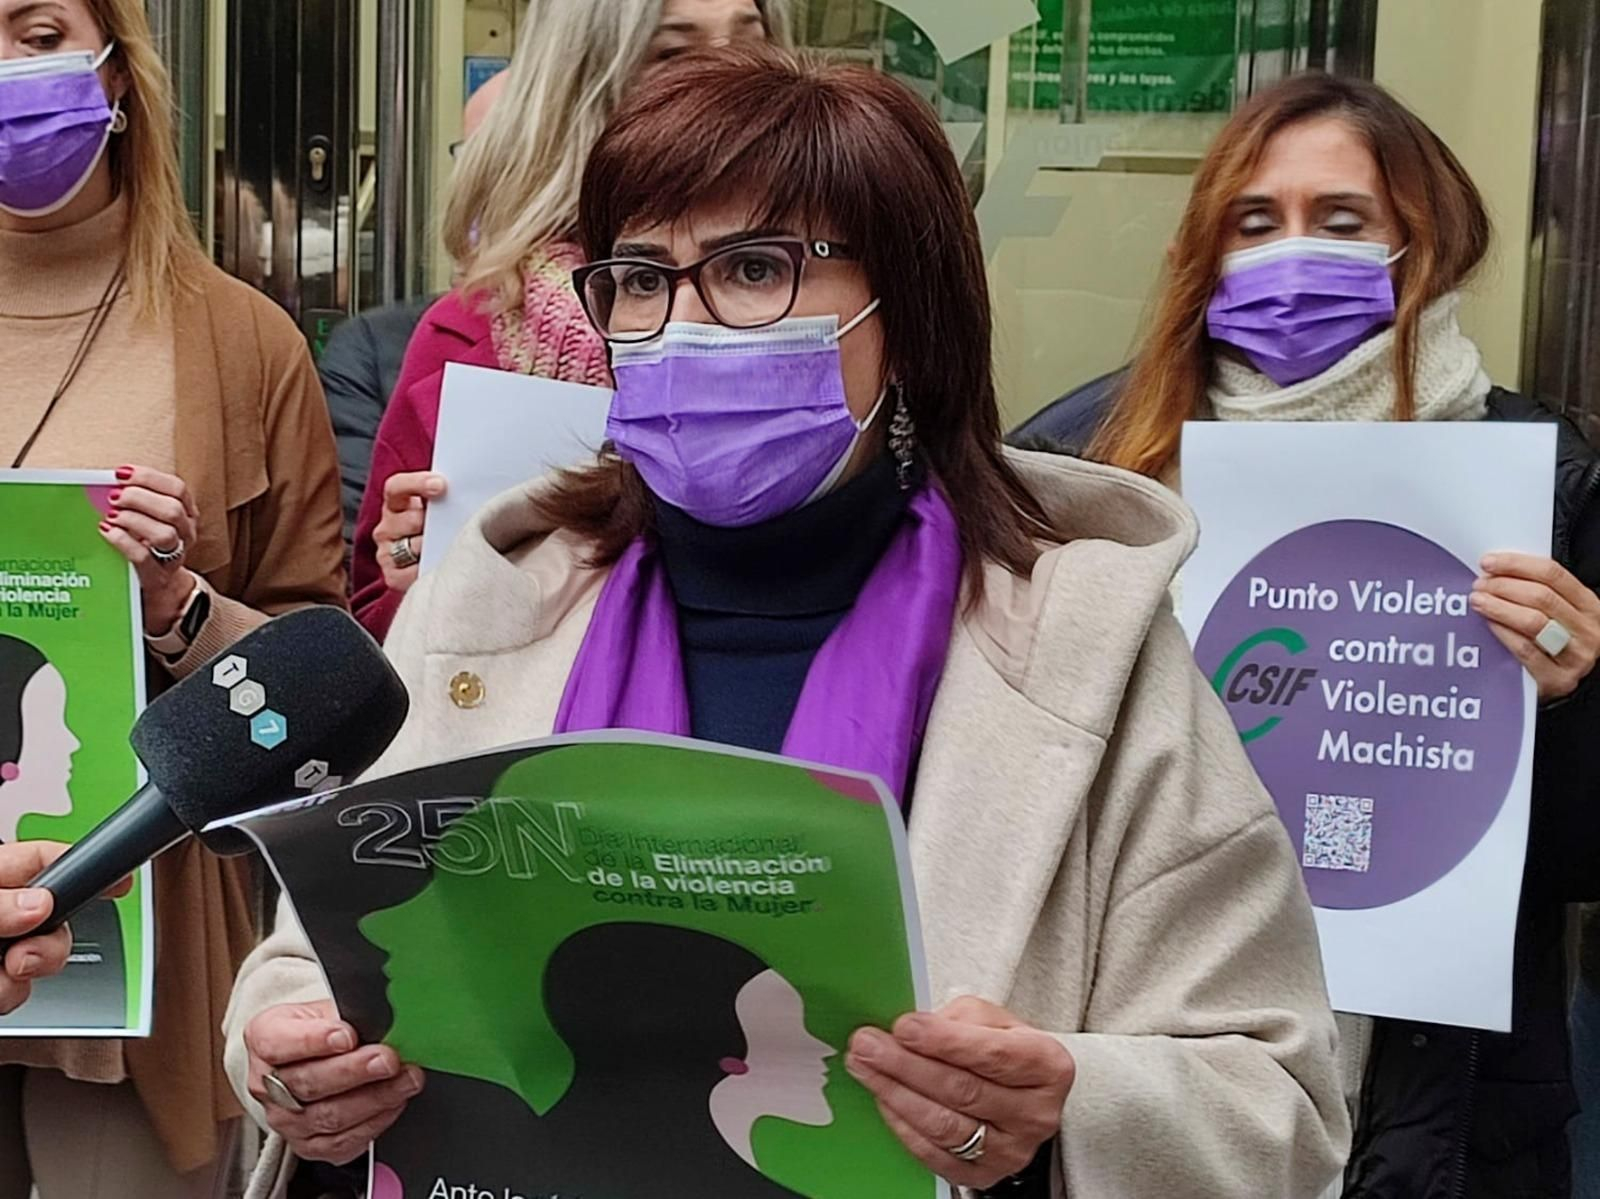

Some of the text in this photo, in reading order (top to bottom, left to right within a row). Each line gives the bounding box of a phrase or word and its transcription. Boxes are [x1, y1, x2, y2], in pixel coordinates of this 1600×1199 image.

[8, 603, 22, 617] la
[1247, 576, 1469, 616] Punto Violeta
[1328, 632, 1481, 668] contra la
[1227, 662, 1318, 708] CSIF
[1321, 679, 1482, 721] Violencia
[1317, 729, 1476, 772] Machista
[336, 796, 586, 882] 25N
[628, 830, 802, 856] Internacional
[583, 848, 829, 877] de la Eliminación
[587, 865, 796, 897] de la violencia
[592, 888, 685, 910] contra
[694, 893, 719, 912] la
